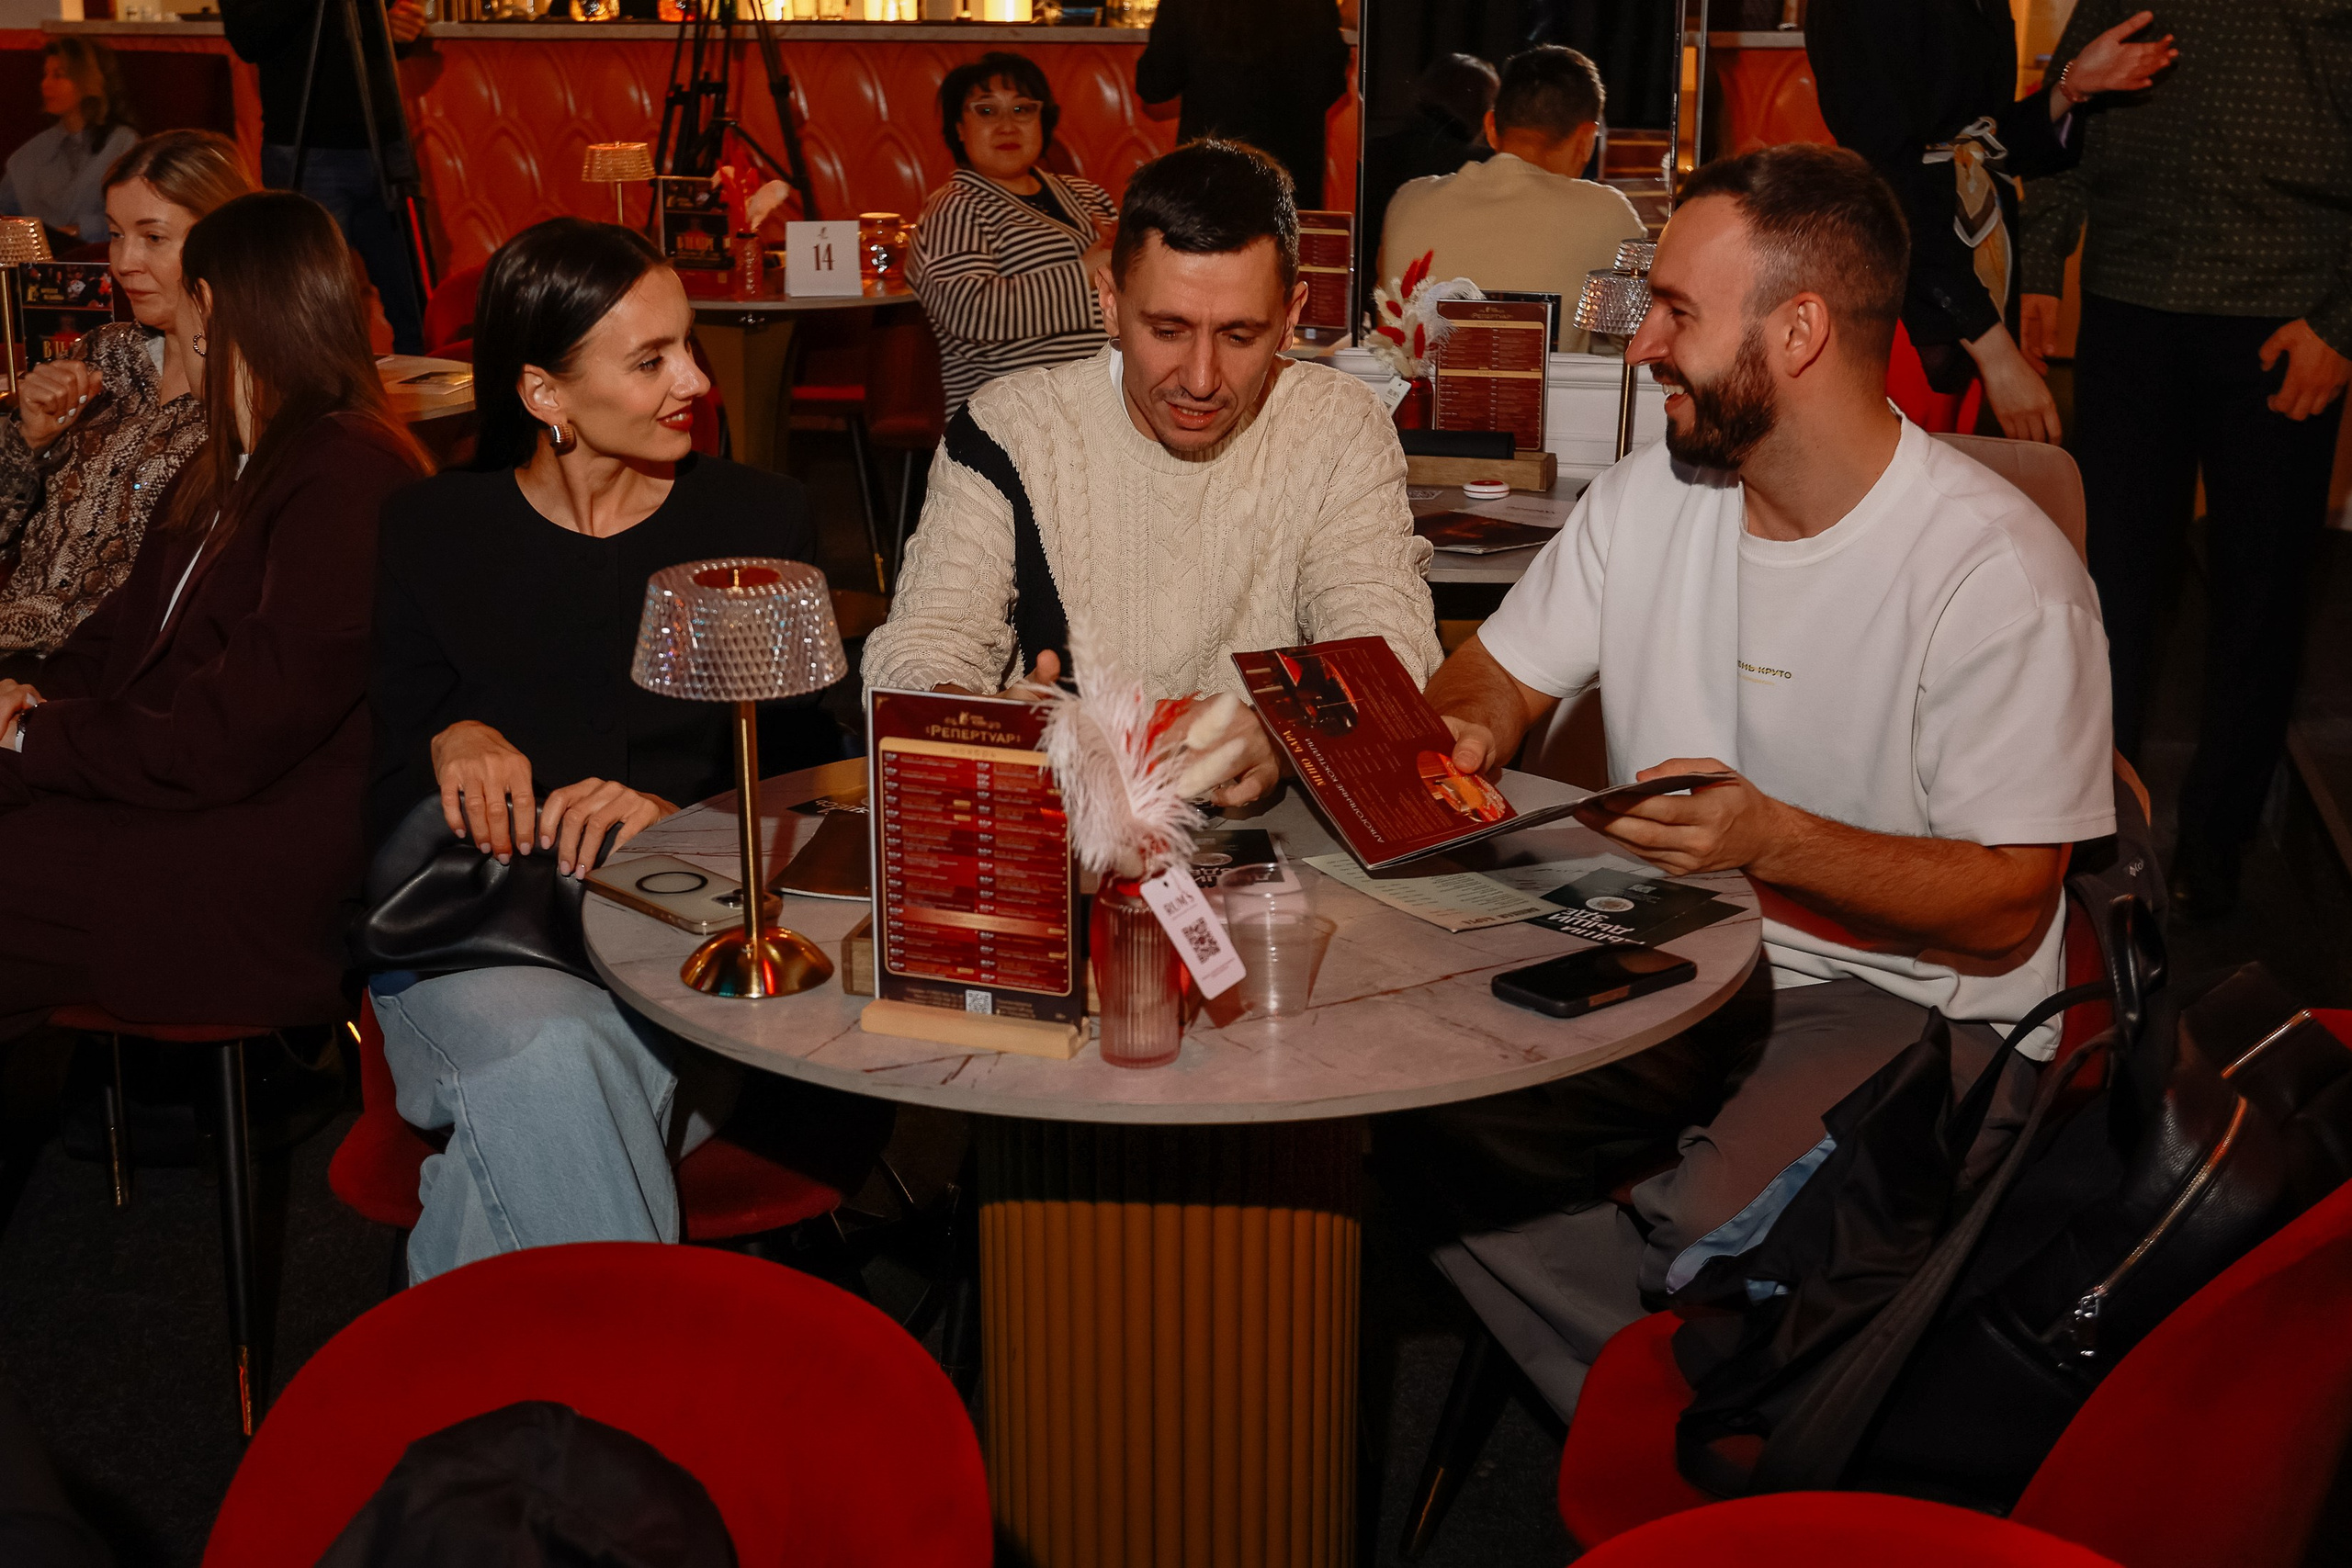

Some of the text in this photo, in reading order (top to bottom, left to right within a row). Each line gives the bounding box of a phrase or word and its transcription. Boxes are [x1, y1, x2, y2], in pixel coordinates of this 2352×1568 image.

[813, 243, 835, 271] 14
[1758, 666, 1792, 680] КРУТО
[1305, 738, 1339, 783] КОКТЕЙЛИ
[1335, 783, 1385, 843] АЛКОГОЛЬНЫЕ
[1547, 913, 1635, 935] ДЫШИ
[1561, 908, 1610, 922] ЗДЕ
